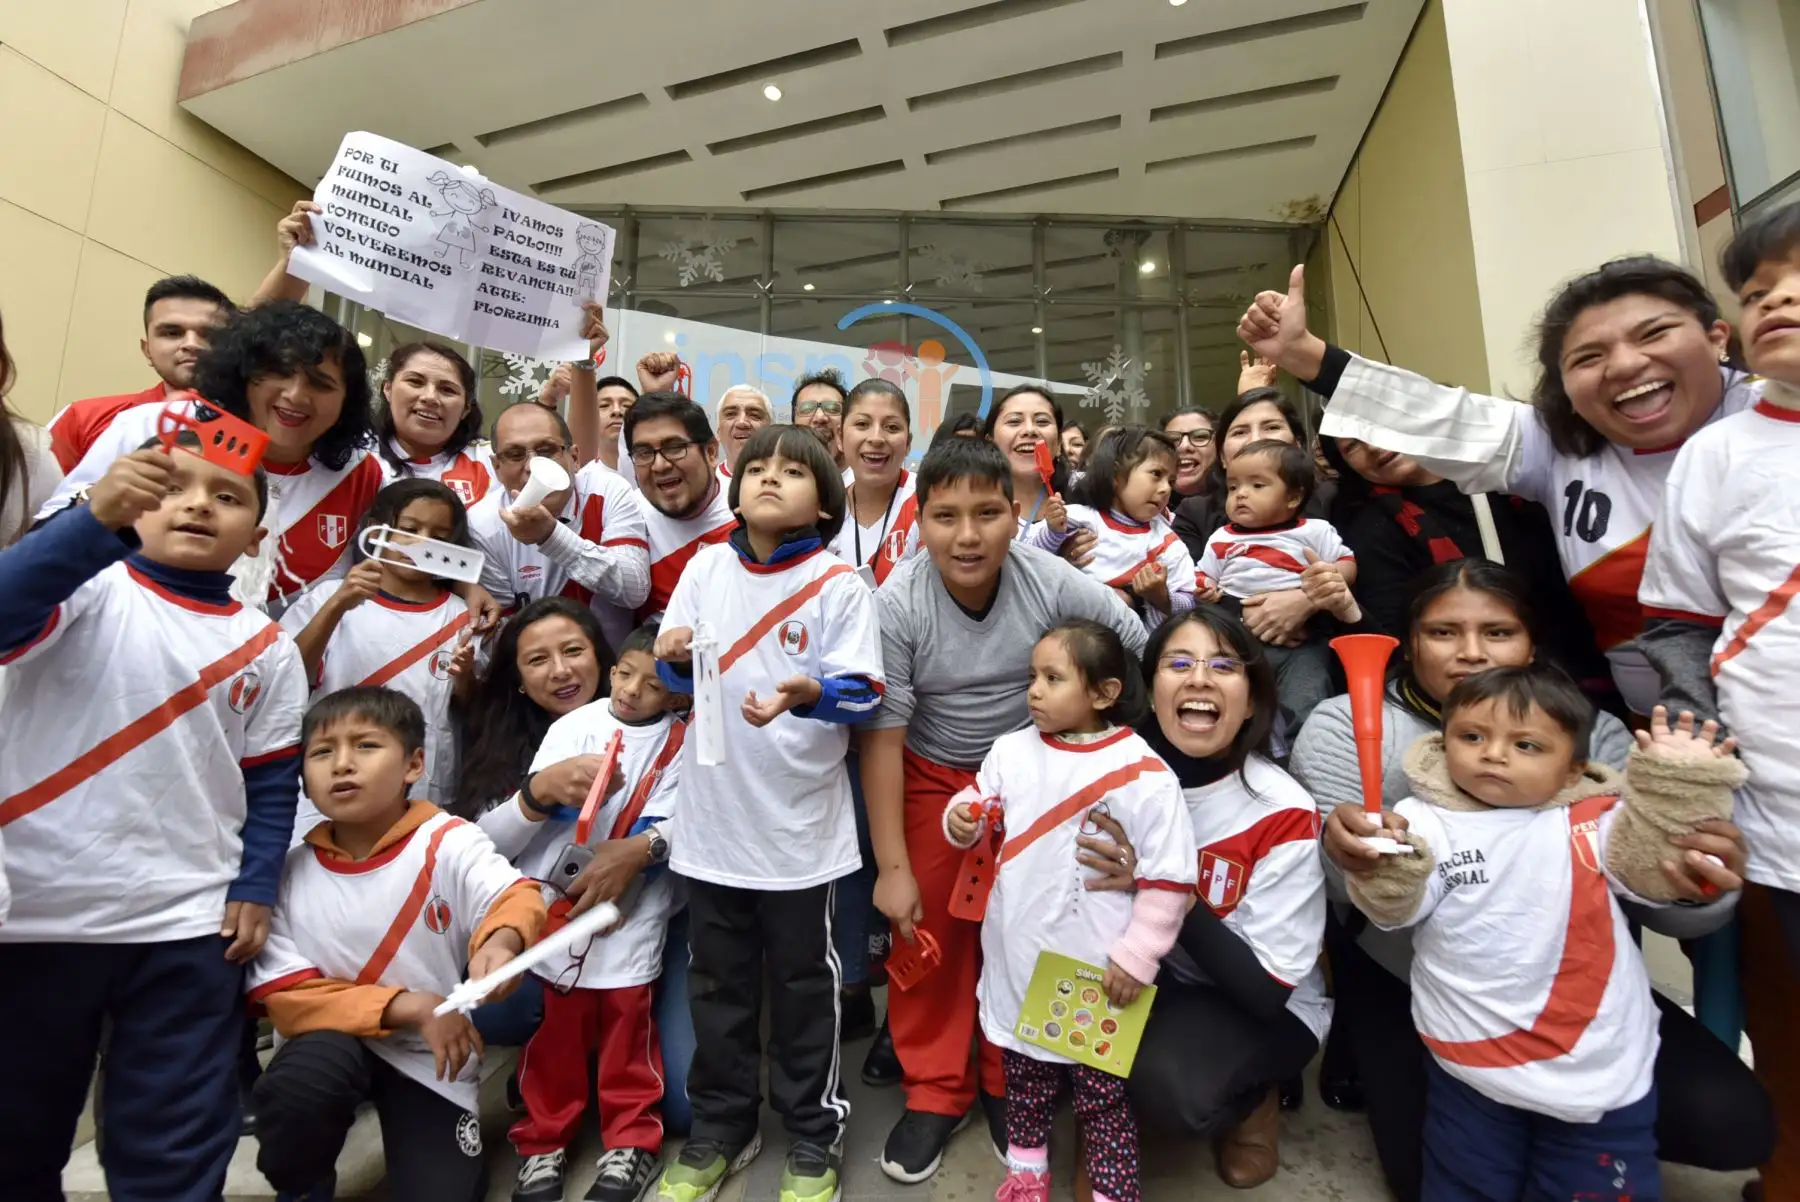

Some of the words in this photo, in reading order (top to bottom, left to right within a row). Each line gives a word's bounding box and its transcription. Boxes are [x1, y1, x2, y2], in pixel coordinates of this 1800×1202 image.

[344, 147, 375, 165] POR
[380, 157, 399, 174] TI
[331, 184, 413, 222] MUNDIAL
[337, 165, 402, 197] FUIMOS
[408, 191, 433, 209] AL
[327, 202, 400, 237] CONTIGO
[323, 220, 453, 276] VOLVEREMOS
[323, 241, 344, 258] AL
[349, 250, 434, 290] MUNDIAL
[488, 244, 532, 268] ESTA
[537, 260, 555, 274] ES
[560, 266, 577, 280] TU
[477, 283, 526, 303] ATTE:
[480, 262, 575, 297] REVANCHA!!
[1564, 479, 1612, 544] 10
